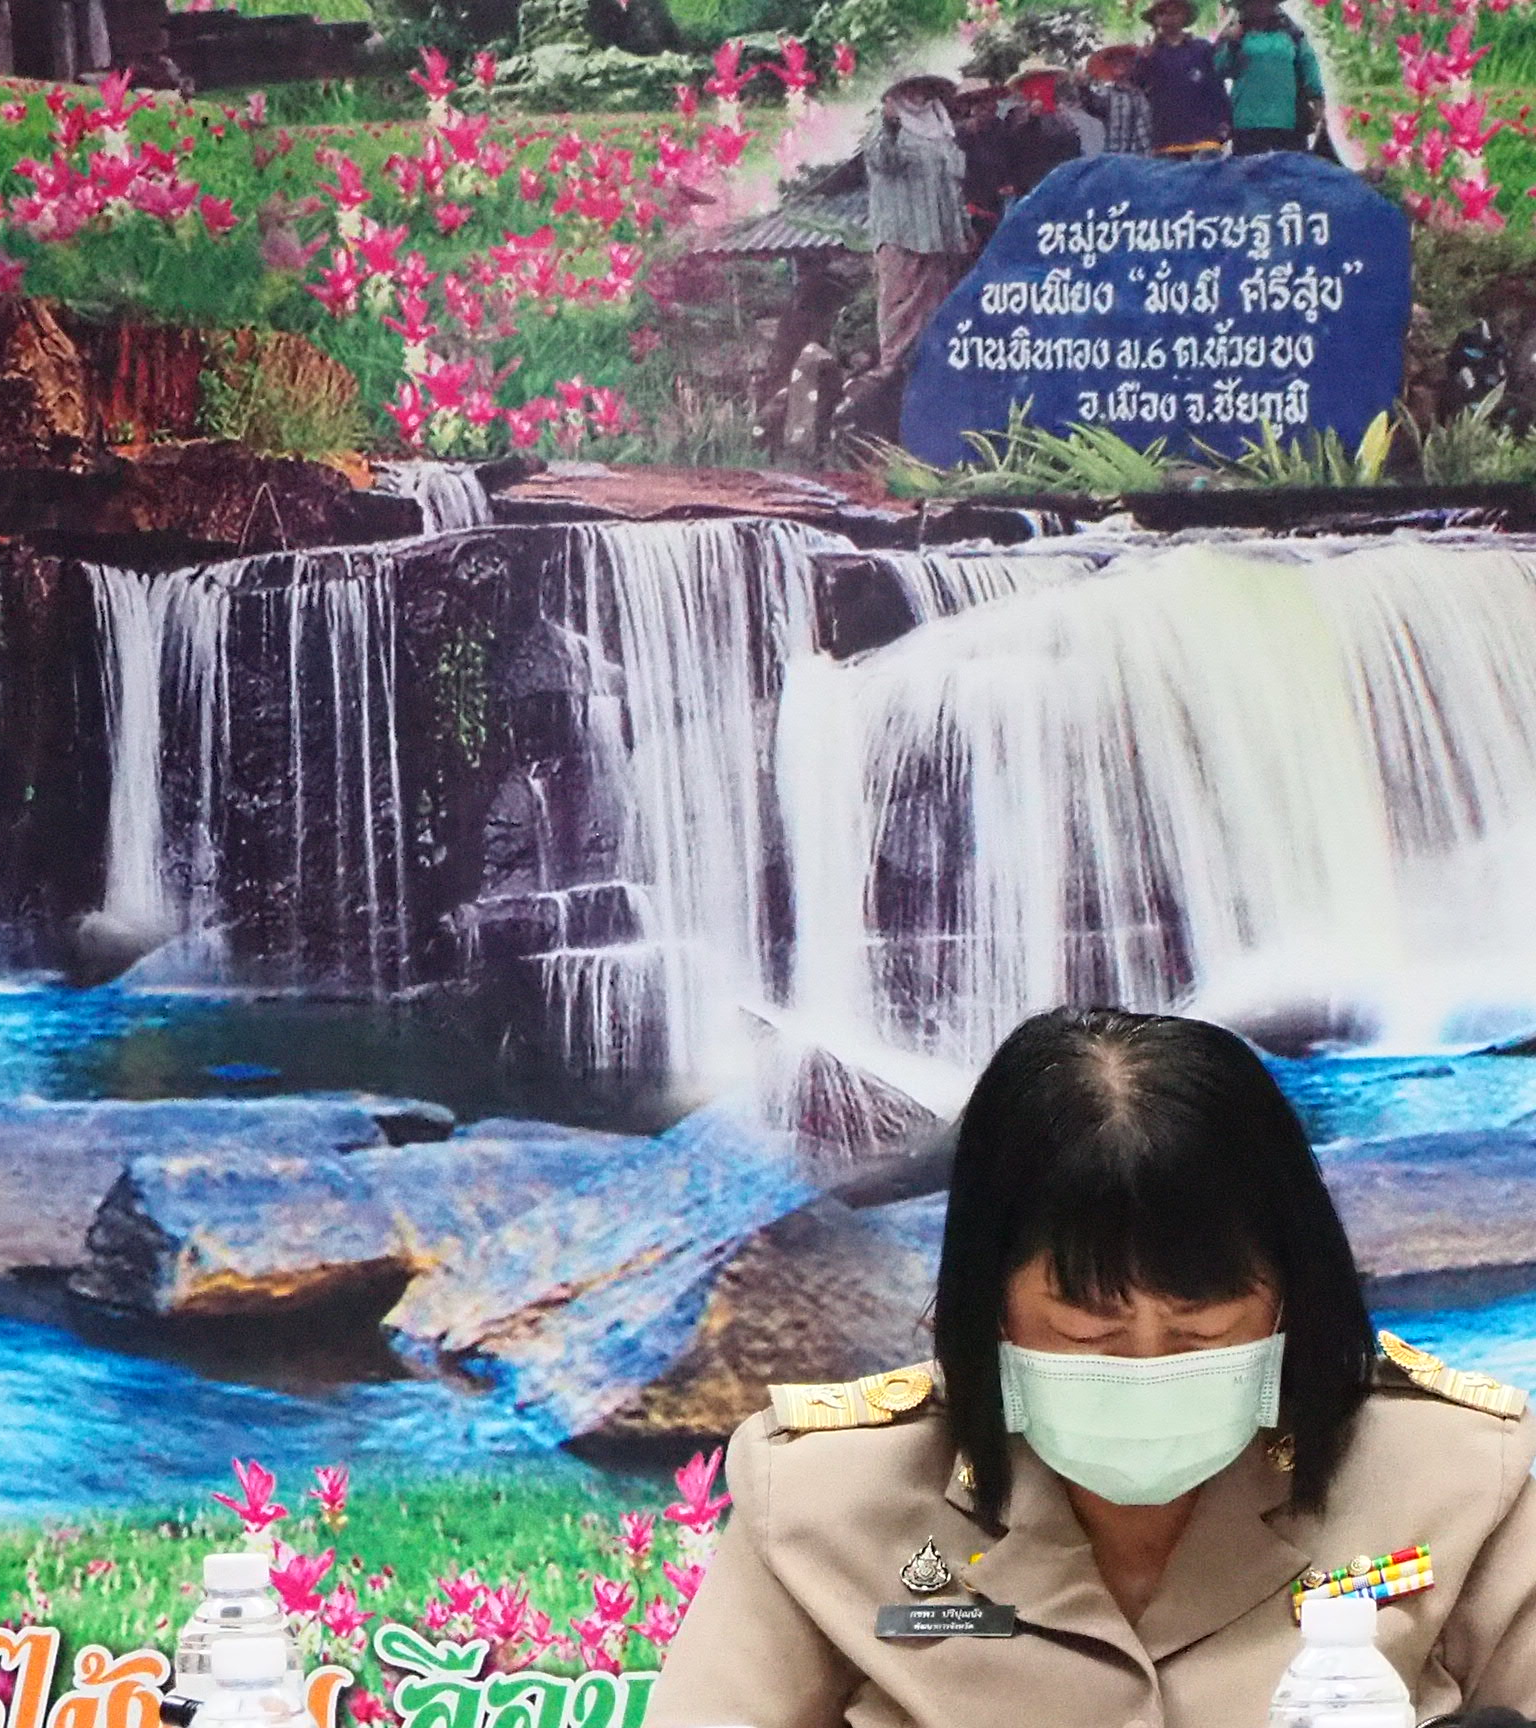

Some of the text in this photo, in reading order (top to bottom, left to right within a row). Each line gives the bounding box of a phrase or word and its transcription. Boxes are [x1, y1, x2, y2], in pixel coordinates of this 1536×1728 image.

[981, 266, 1114, 315] พอเพียง
[1116, 337, 1167, 370] ม.6
[1077, 376, 1310, 438] อ.เมือง จ.ชัยภูมิ
